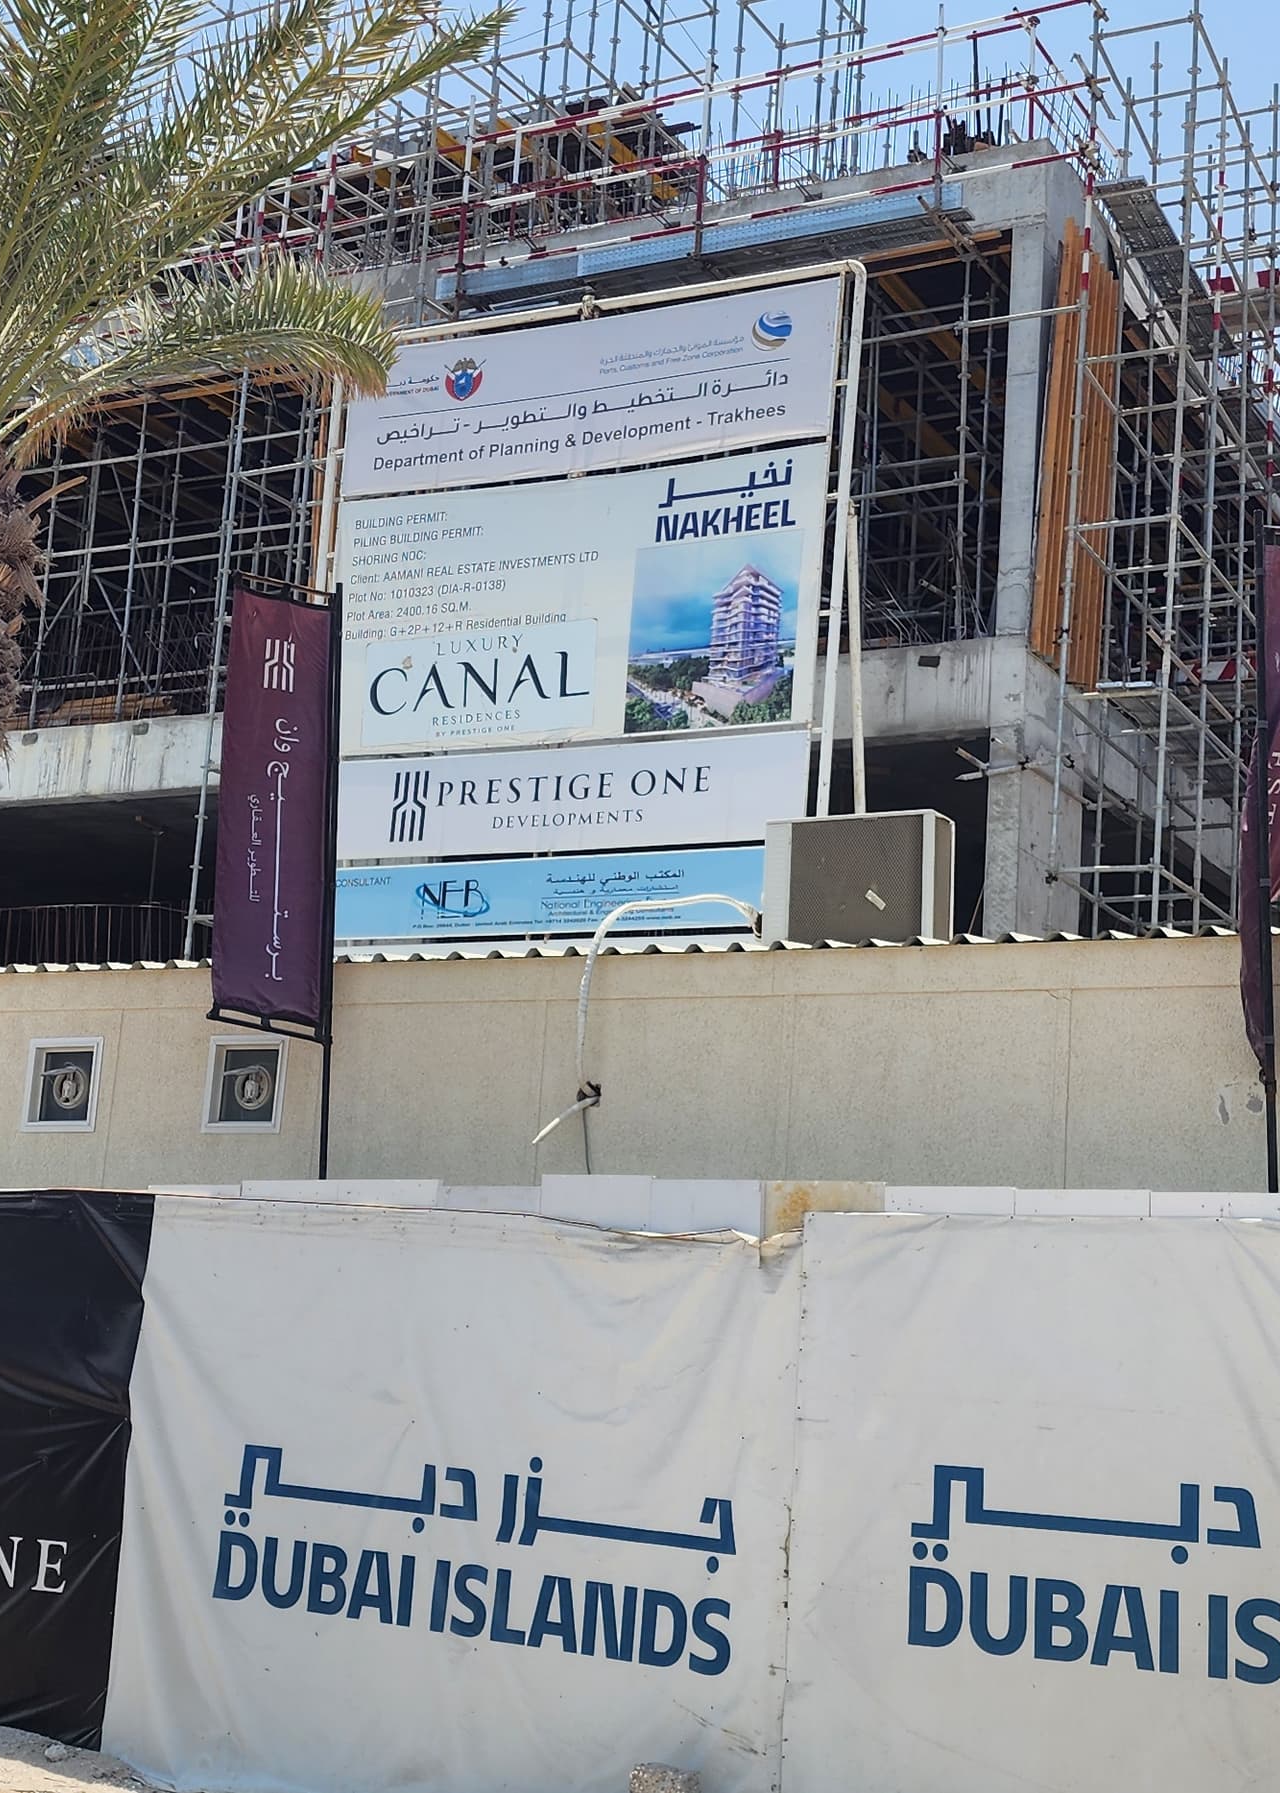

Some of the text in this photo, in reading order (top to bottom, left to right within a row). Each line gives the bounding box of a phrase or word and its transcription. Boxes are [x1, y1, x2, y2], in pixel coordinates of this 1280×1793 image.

[651, 357, 665, 367] and
[666, 354, 681, 364] Free
[682, 352, 700, 362] Zone
[702, 346, 744, 360] Corporation
[373, 449, 464, 471] Department
[469, 445, 485, 460] of
[489, 435, 559, 459] Planning
[564, 433, 577, 447] &
[582, 416, 691, 446] Development
[707, 403, 786, 427] Trakhees
[355, 511, 448, 530] BUILDING PERMIT:
[655, 499, 796, 543] NAKHEEL
[353, 525, 484, 548] PILING BUILDING PERMIT:
[350, 550, 599, 585] Client: AAMANI REAL ESTATE INVESTMENTS LTD
[352, 549, 427, 567] SHORING NOC:
[348, 579, 506, 604] Plot No: 1010323 (DIA-R-0138)
[346, 601, 472, 622] Plot Area: 2400.16 SQ.M.
[344, 628, 387, 641] Building:
[465, 614, 522, 631] Residential
[525, 612, 567, 626] Building
[435, 633, 524, 656] LUXURY
[369, 651, 590, 716] CANAL
[432, 709, 521, 727] RESIDENCES
[450, 726, 493, 737] PRESTIGE
[496, 724, 515, 733] ONE
[436, 765, 712, 807] PRESTIGE ONE
[492, 808, 644, 830] DEVELOPMENTS
[336, 876, 392, 888] CONSULTANT
[540, 899, 580, 909] National
[212, 1530, 732, 1677] DUBAI ISLANDS
[907, 1564, 1180, 1674] DUBAI
